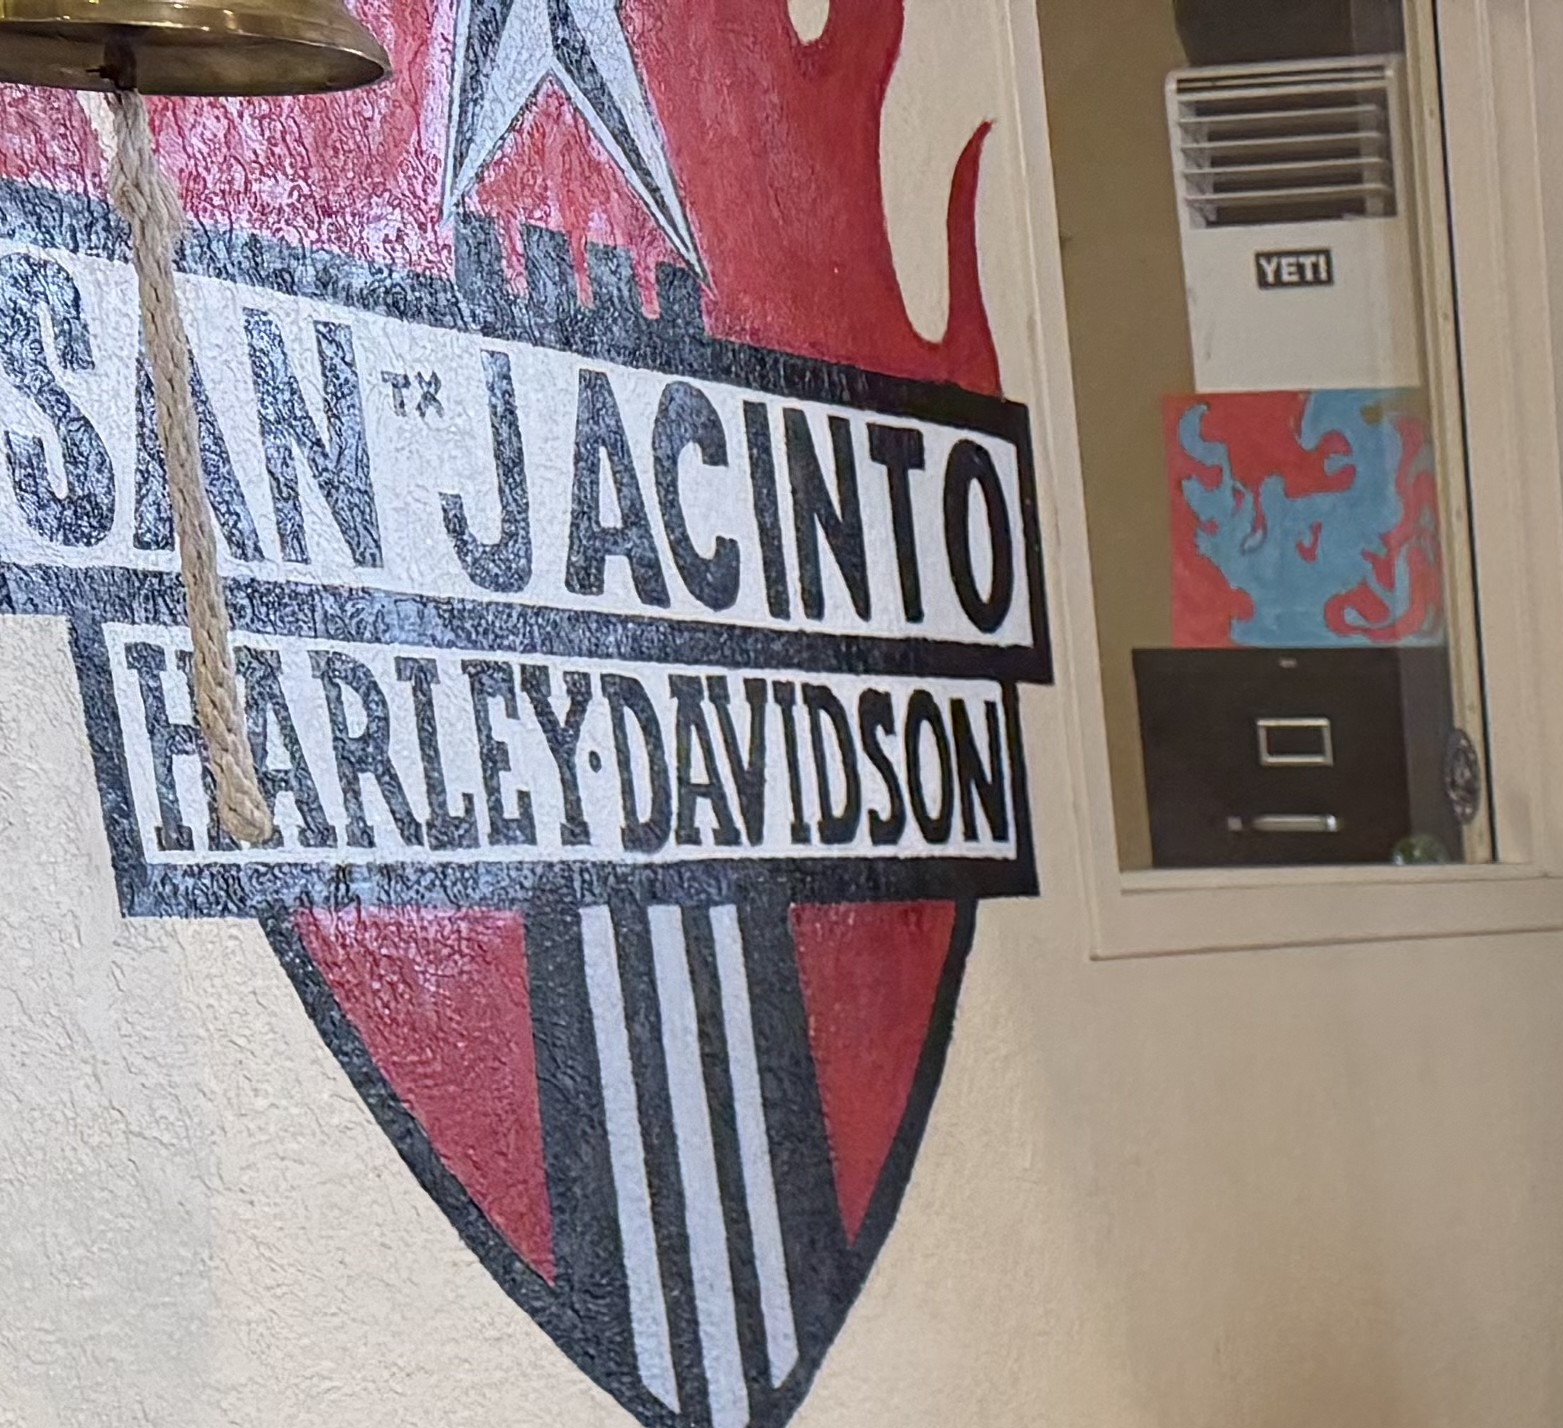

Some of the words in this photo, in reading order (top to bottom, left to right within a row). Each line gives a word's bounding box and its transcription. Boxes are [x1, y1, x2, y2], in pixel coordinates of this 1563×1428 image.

[1258, 253, 1330, 285] YETI
[0, 252, 383, 570] SAN
[380, 368, 444, 420] TX
[440, 348, 1014, 637] JACINTO
